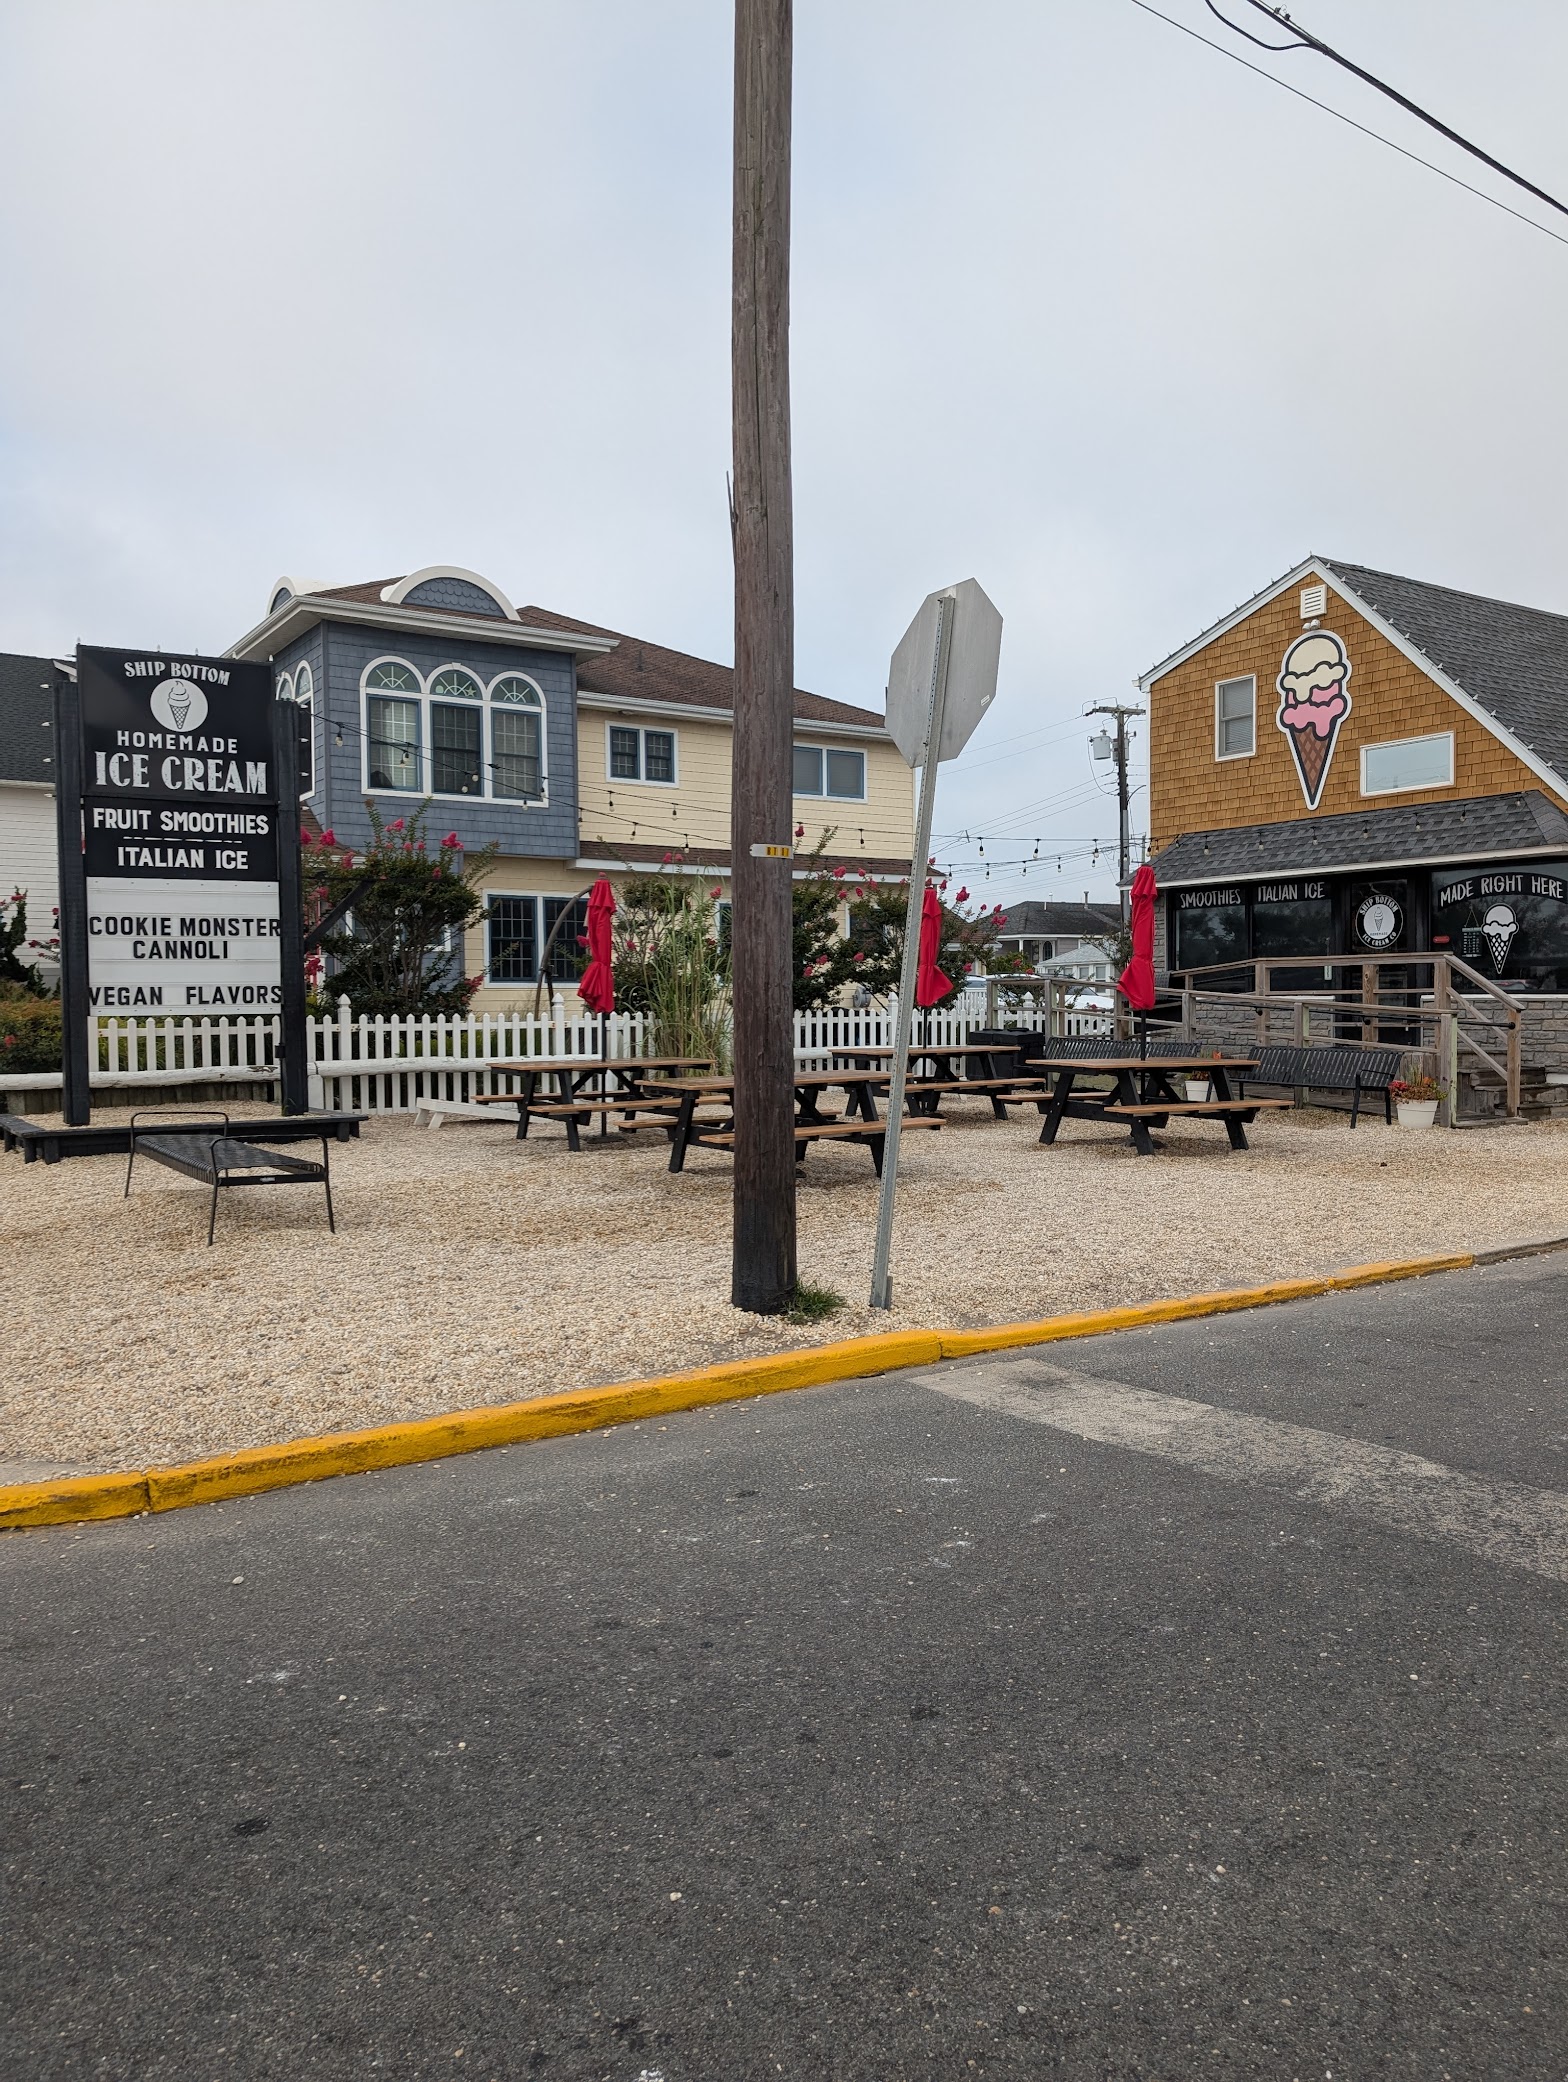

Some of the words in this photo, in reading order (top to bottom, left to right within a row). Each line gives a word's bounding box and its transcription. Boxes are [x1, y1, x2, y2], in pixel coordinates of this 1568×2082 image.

[124, 661, 165, 678] SHIP
[170, 662, 230, 686] BOTTOM
[117, 730, 238, 754] HOMEMADE
[95, 751, 150, 788] ICE
[161, 755, 267, 794] CREAM
[93, 808, 151, 830] FRUIT
[160, 811, 269, 835] SMOOTHIES
[118, 847, 204, 868] ITALIAN
[215, 849, 248, 869] ICE
[1180, 889, 1241, 908] SMOOTHIES
[1258, 884, 1298, 902] ITALIAN
[1304, 882, 1325, 899] ICE
[1440, 880, 1474, 907] MADE
[1481, 875, 1523, 895] RIGHT
[1531, 876, 1563, 899] HERE
[1359, 898, 1374, 915] SHIP
[1375, 896, 1399, 912] BOTTOM
[89, 916, 171, 936] COOKIE
[180, 917, 280, 937] MONSTER
[133, 940, 228, 959] CANNOLI
[1362, 933, 1371, 943] ICE
[1371, 938, 1389, 946] CREAM
[89, 986, 162, 1006] VEGAN
[186, 985, 282, 1005] FLAVORS
